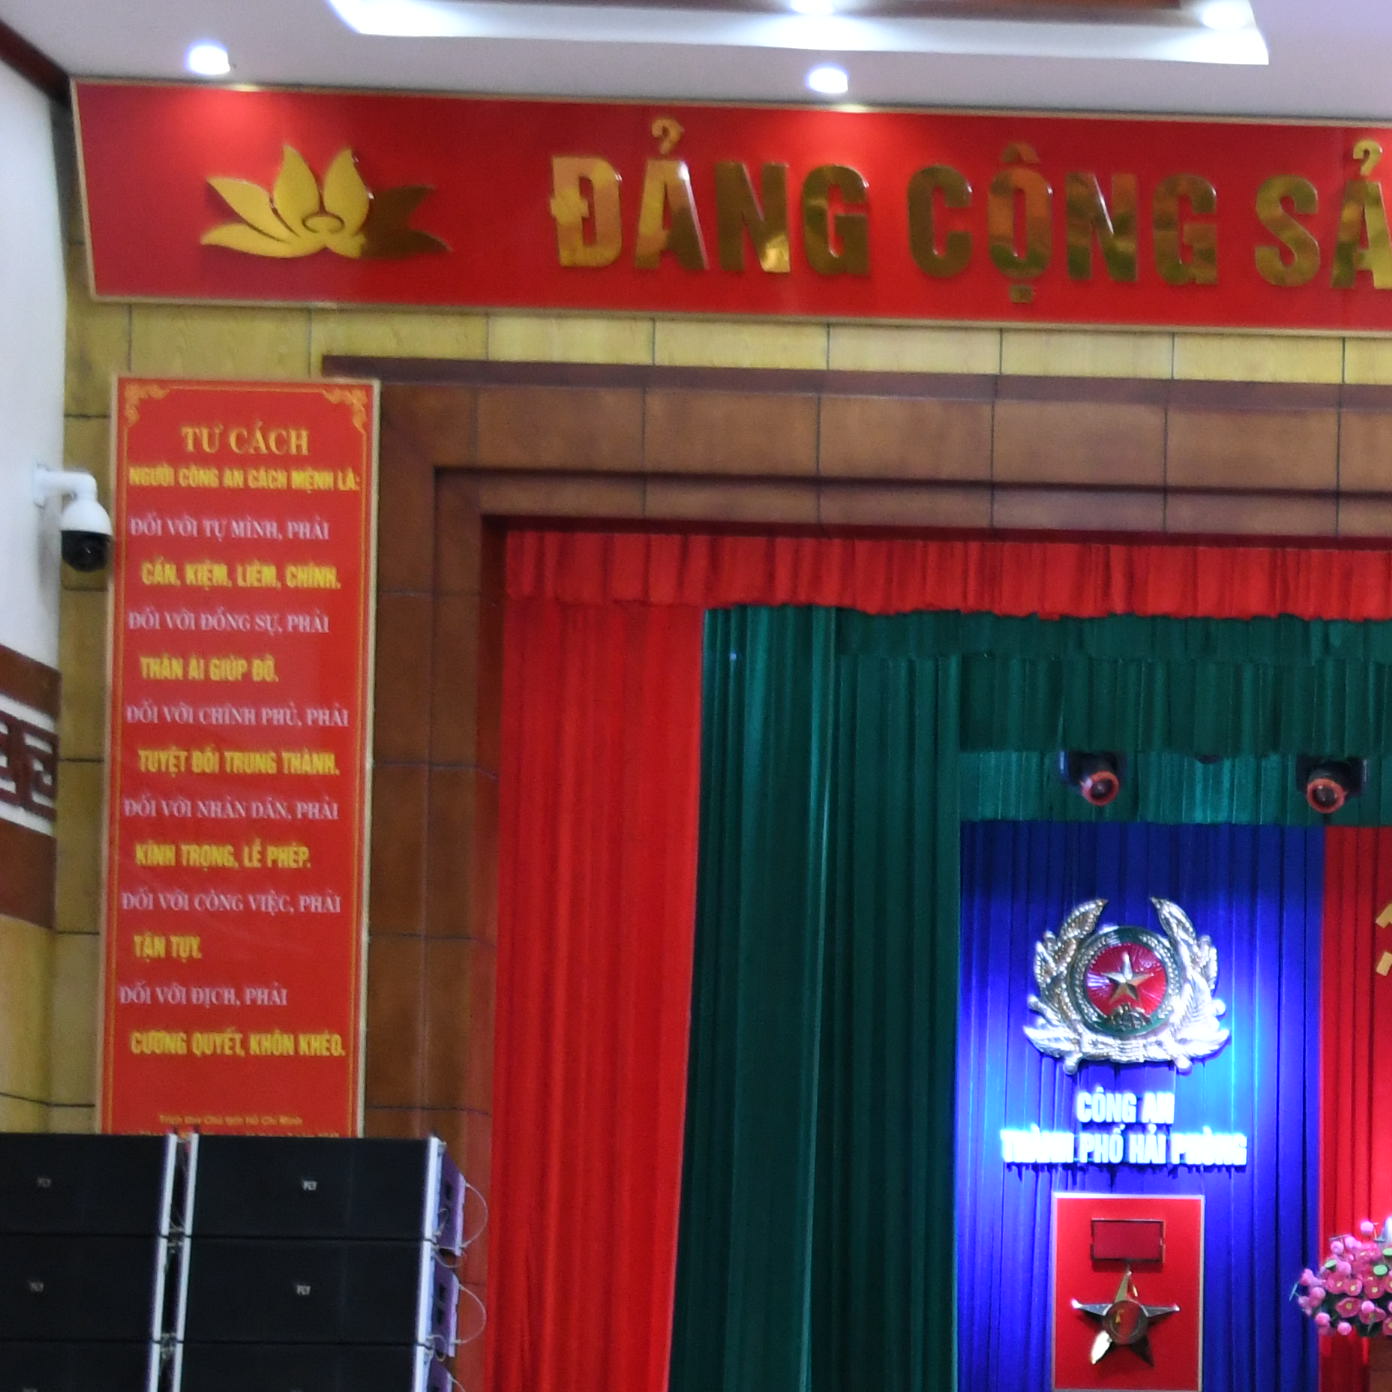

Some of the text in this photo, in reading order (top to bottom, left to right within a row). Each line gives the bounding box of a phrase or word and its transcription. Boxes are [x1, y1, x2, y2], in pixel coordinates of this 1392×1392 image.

[550, 117, 868, 277] ĐẢNG
[907, 143, 1217, 303] CỘNG
[181, 420, 309, 455] TƯ CÁCH
[178, 464, 220, 488] CÔNG
[223, 467, 245, 488] AN
[247, 466, 288, 490] CÁCH
[290, 466, 335, 493] MỆNH
[203, 518, 228, 542] TỰ
[287, 515, 329, 540] PHẢI
[287, 609, 329, 633] PHẢI
[138, 745, 189, 777] TUYỆT
[224, 749, 278, 774] TRUNG
[1076, 1086, 1175, 1124] CÔNG AN
[1129, 1124, 1167, 1164] HẢI
